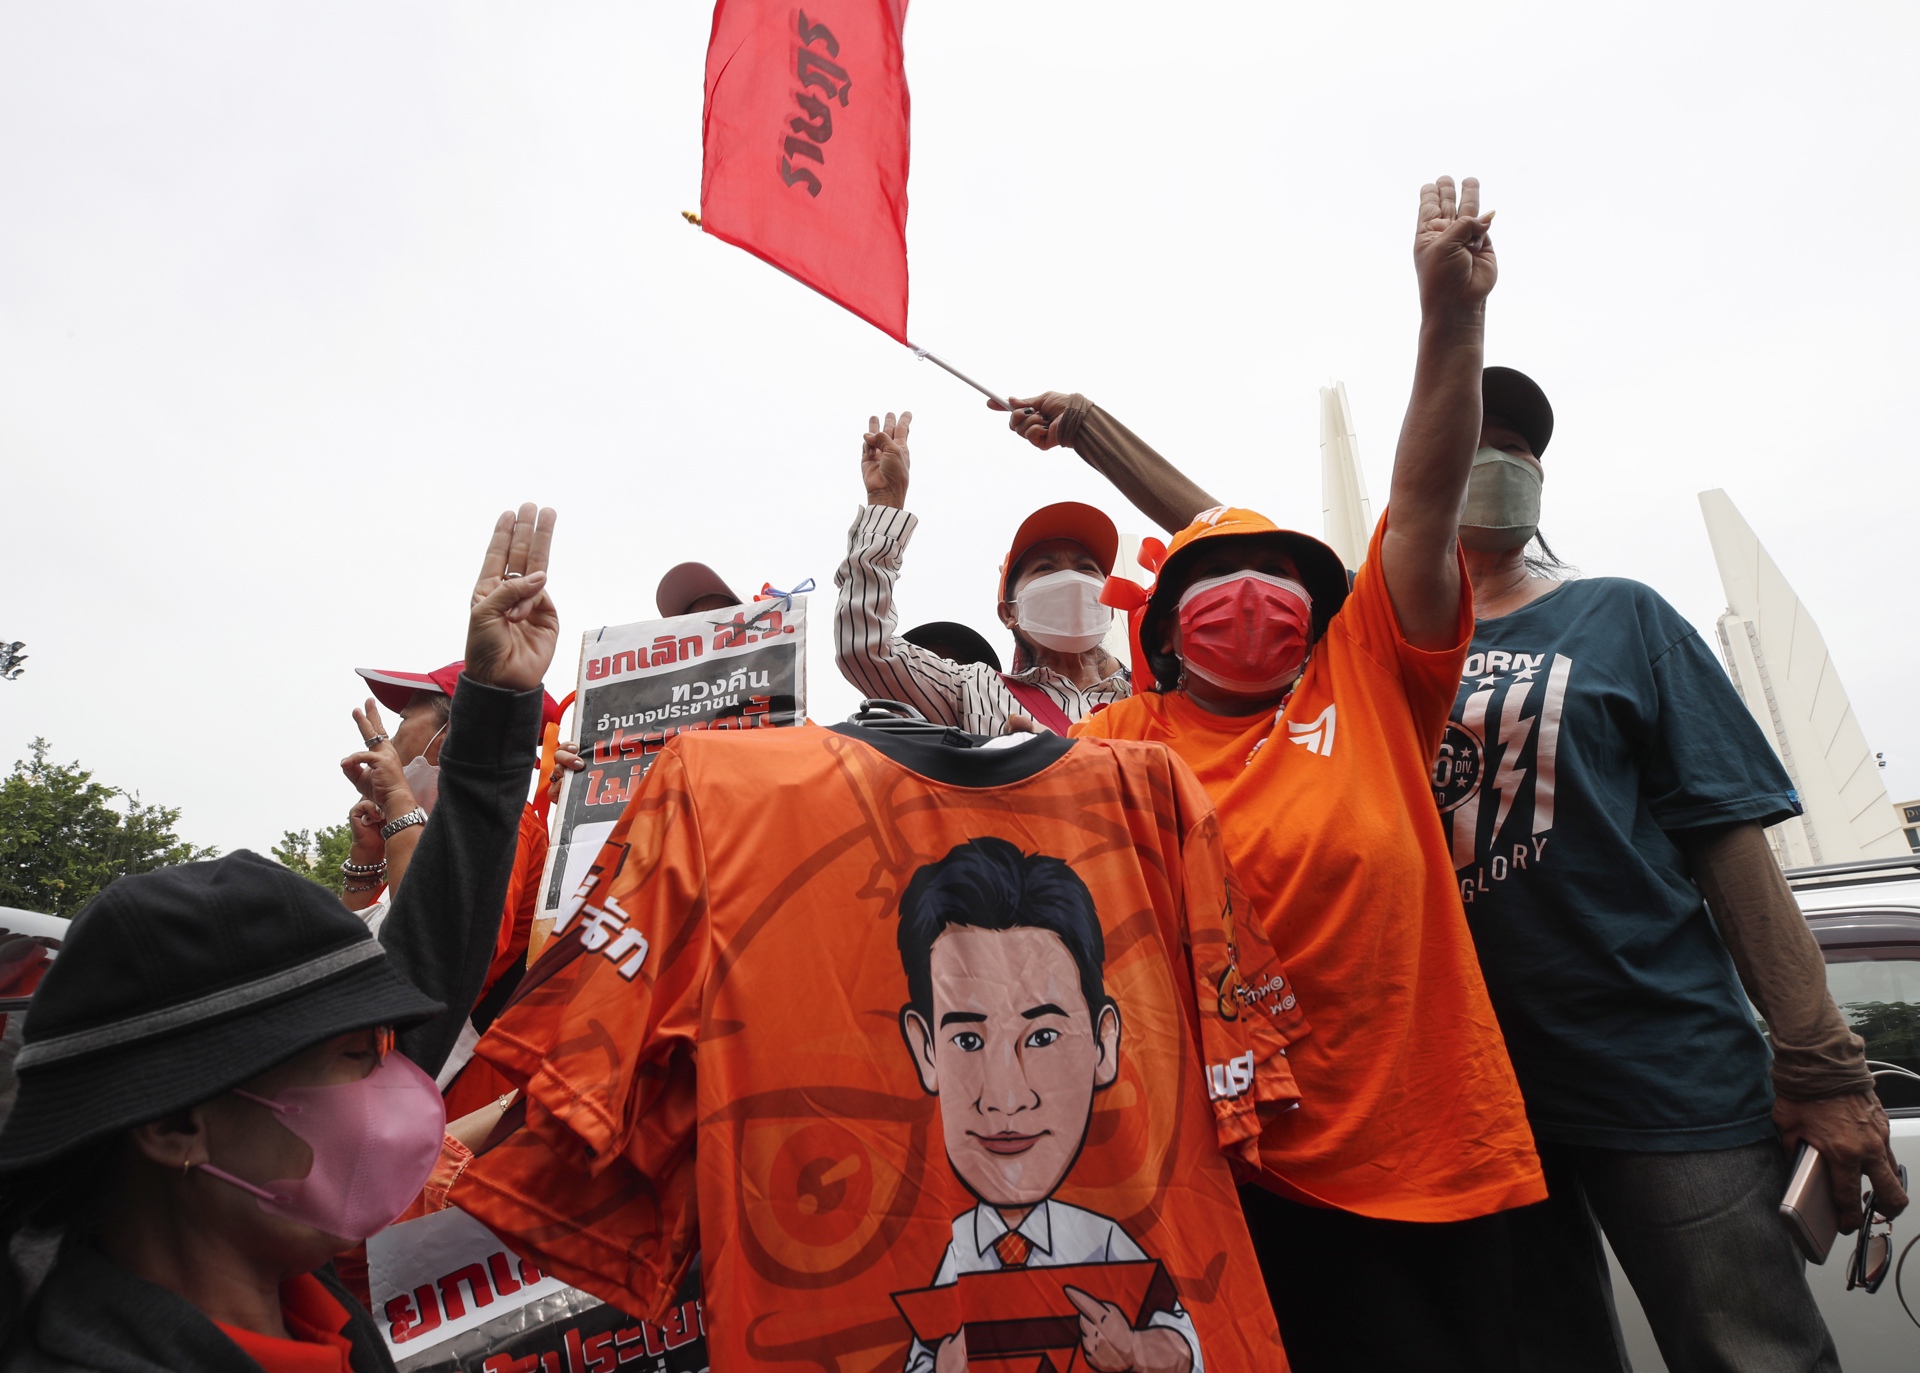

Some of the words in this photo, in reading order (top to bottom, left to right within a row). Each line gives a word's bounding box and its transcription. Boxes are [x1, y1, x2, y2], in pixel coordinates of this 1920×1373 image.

[586, 634, 704, 681] ยกเลิก
[672, 667, 770, 702] ทวงคืน
[597, 694, 739, 732] อำนาจประชาชน
[1455, 760, 1473, 774] DIV.
[1461, 836, 1548, 903] GLORY
